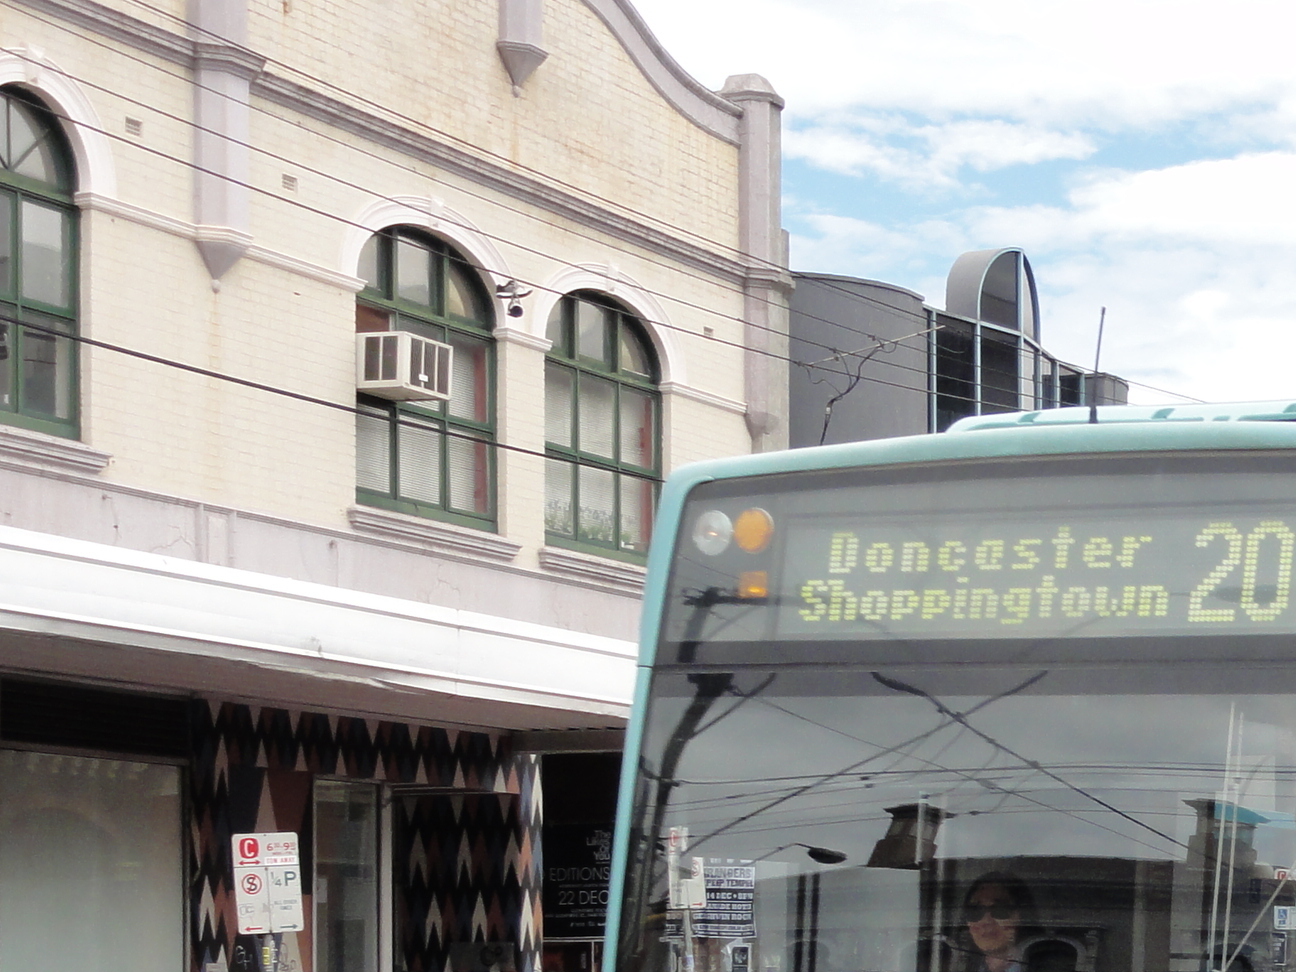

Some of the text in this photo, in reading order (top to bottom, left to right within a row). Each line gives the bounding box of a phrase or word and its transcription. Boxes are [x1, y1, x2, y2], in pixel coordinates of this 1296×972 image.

[828, 526, 1152, 573] Doncaster
[799, 575, 1169, 624] Shoppingtown
[284, 871, 296, 887] P
[549, 867, 610, 881] EDITIONS
[558, 890, 575, 905] 22
